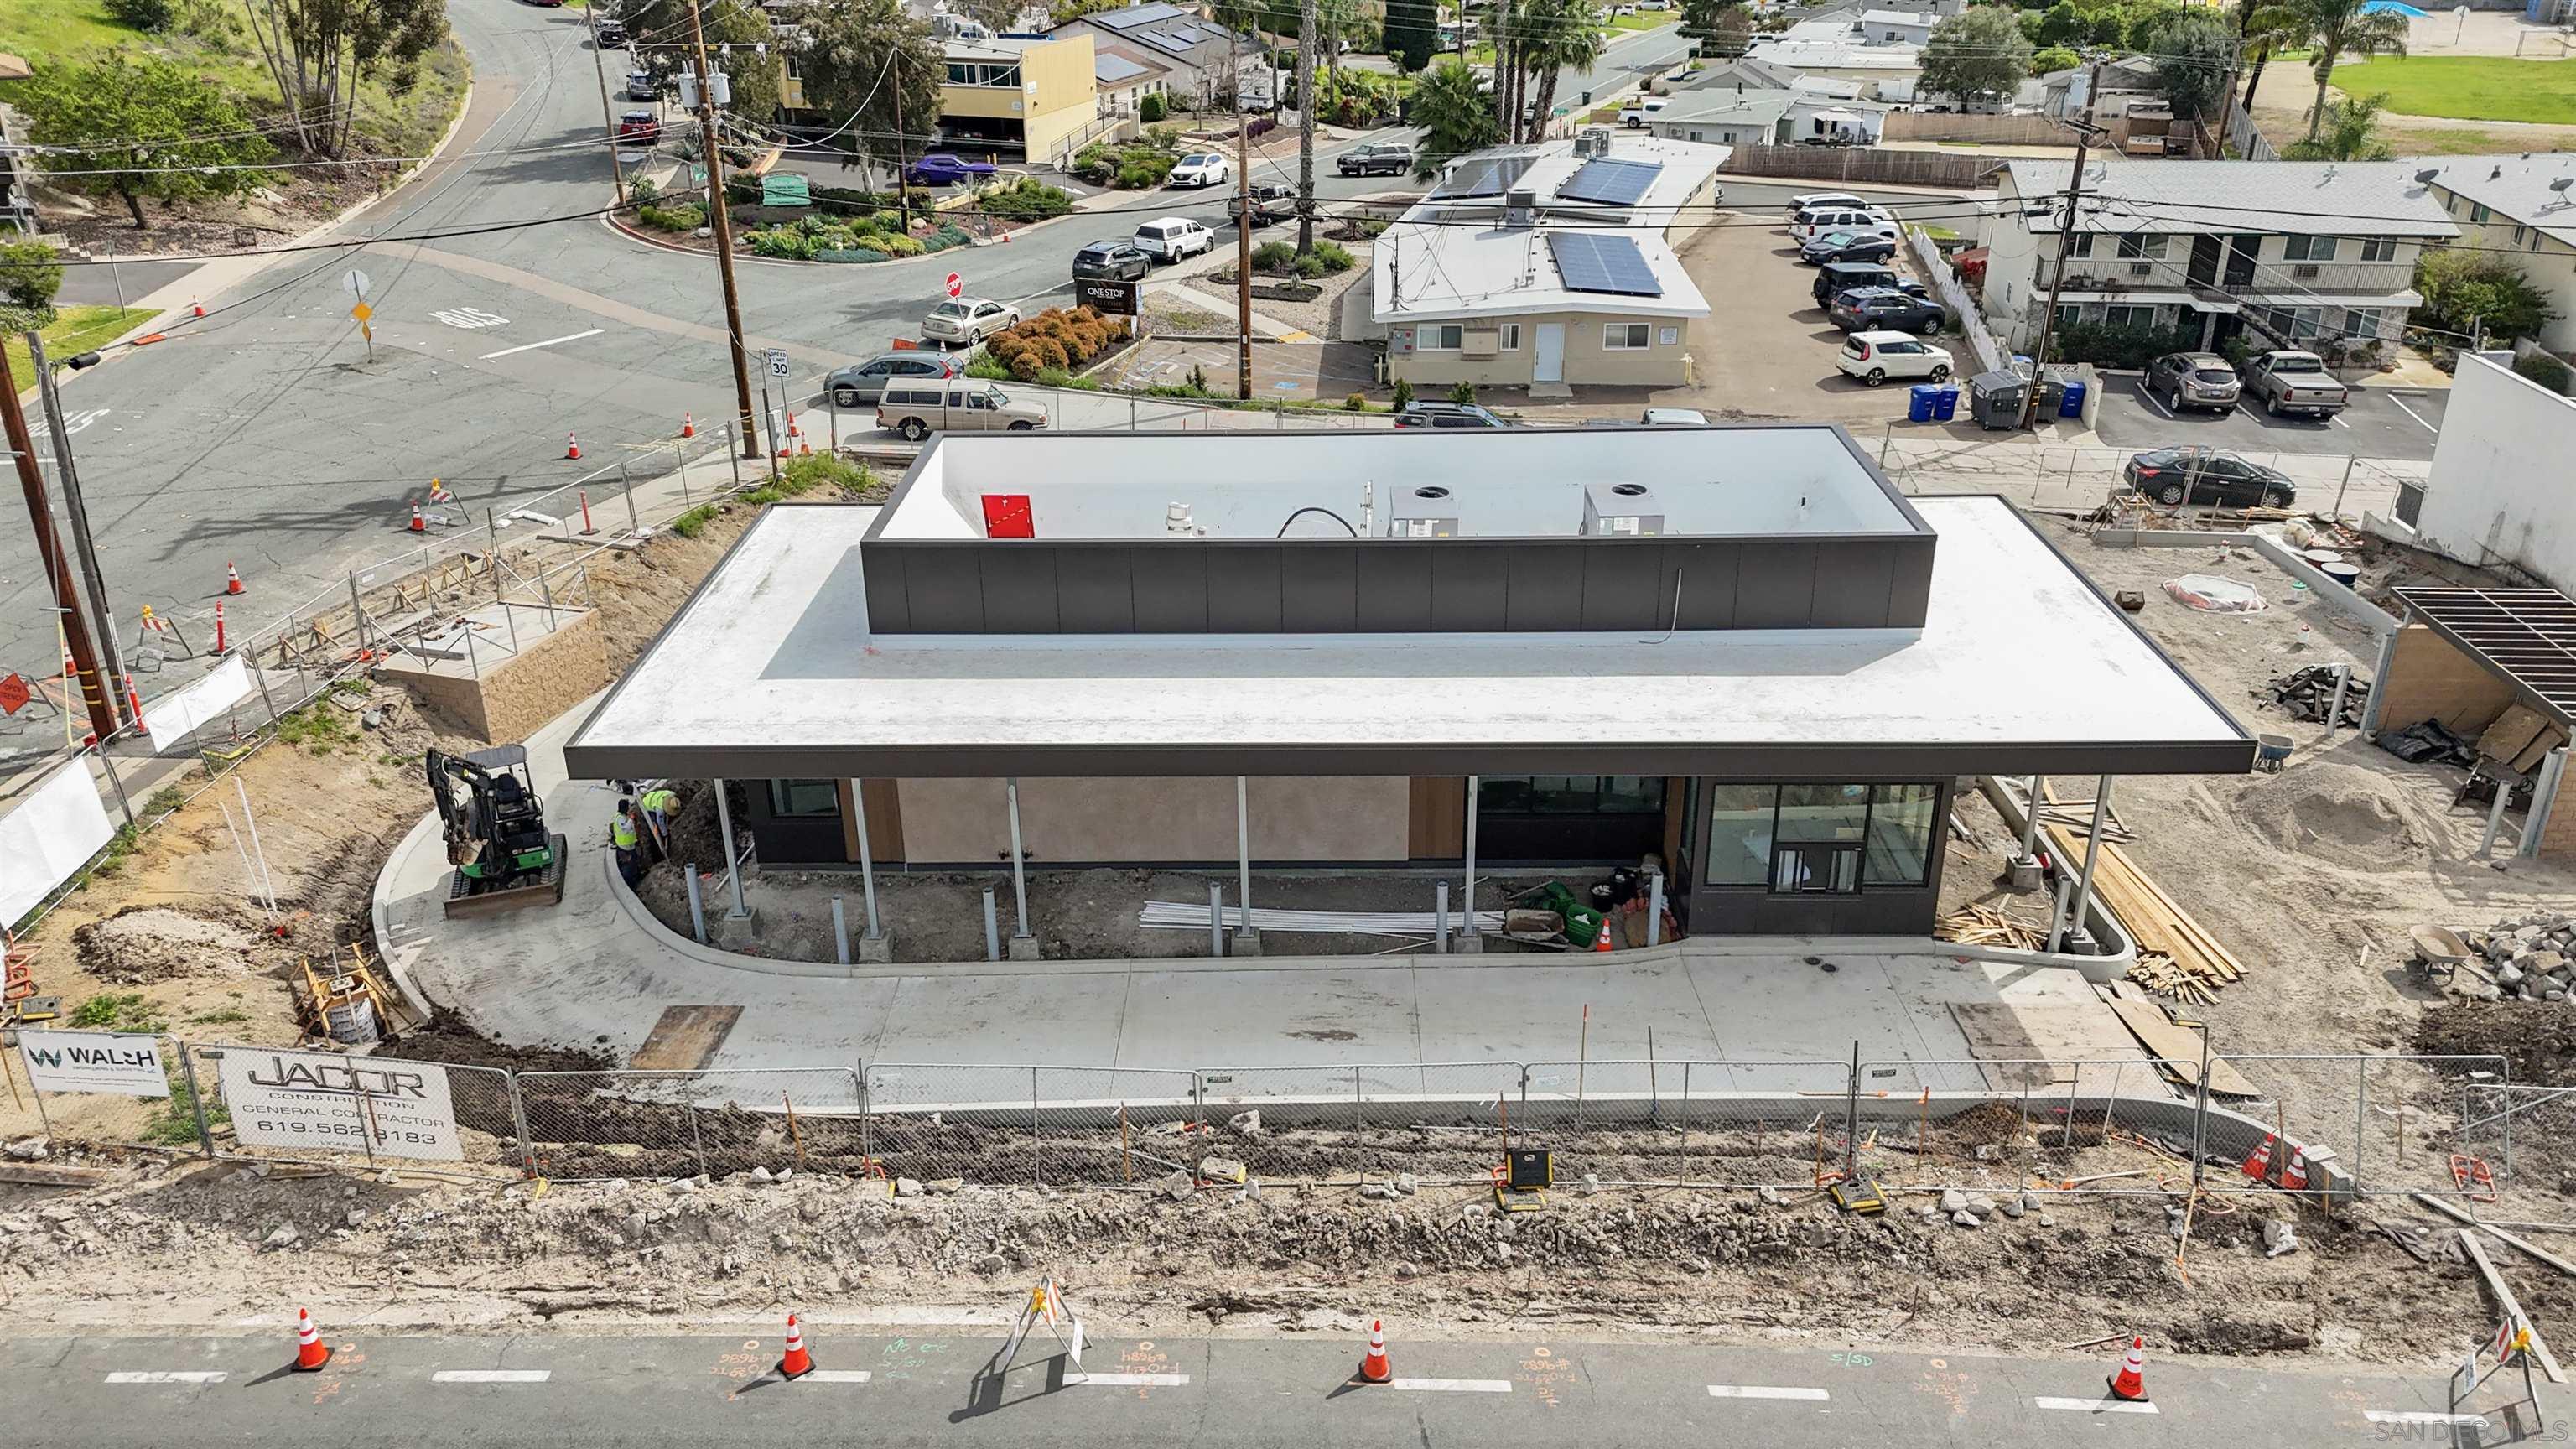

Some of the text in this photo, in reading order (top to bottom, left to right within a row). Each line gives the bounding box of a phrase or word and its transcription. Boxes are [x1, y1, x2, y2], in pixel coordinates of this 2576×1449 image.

[947, 278, 961, 293] STOP
[1088, 287, 1104, 296] ONE
[1104, 288, 1124, 298] STOP
[773, 363, 787, 374] 30
[247, 1056, 428, 1098] JACOR
[242, 1104, 325, 1116] GENERAL
